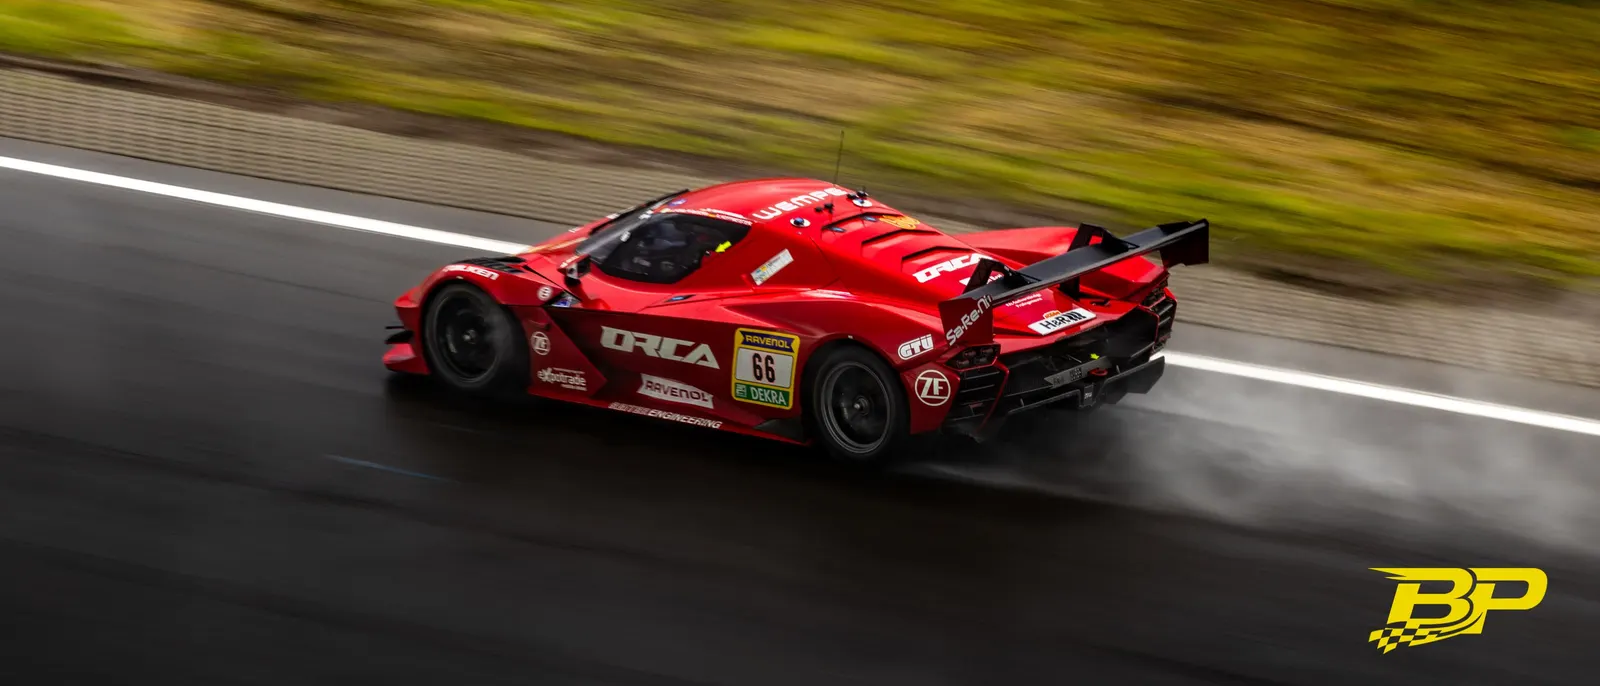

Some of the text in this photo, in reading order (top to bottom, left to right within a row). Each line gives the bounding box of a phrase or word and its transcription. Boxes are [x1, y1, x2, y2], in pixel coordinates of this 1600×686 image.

[531, 334, 550, 354] ZF
[600, 325, 720, 370] ORCA
[745, 335, 790, 349] RAVENOL
[752, 352, 776, 382] 66
[645, 380, 710, 403] RAVENOL
[750, 386, 787, 406] DEKRA
[916, 374, 950, 402] ZF
[648, 408, 723, 429] ENGINEERING
